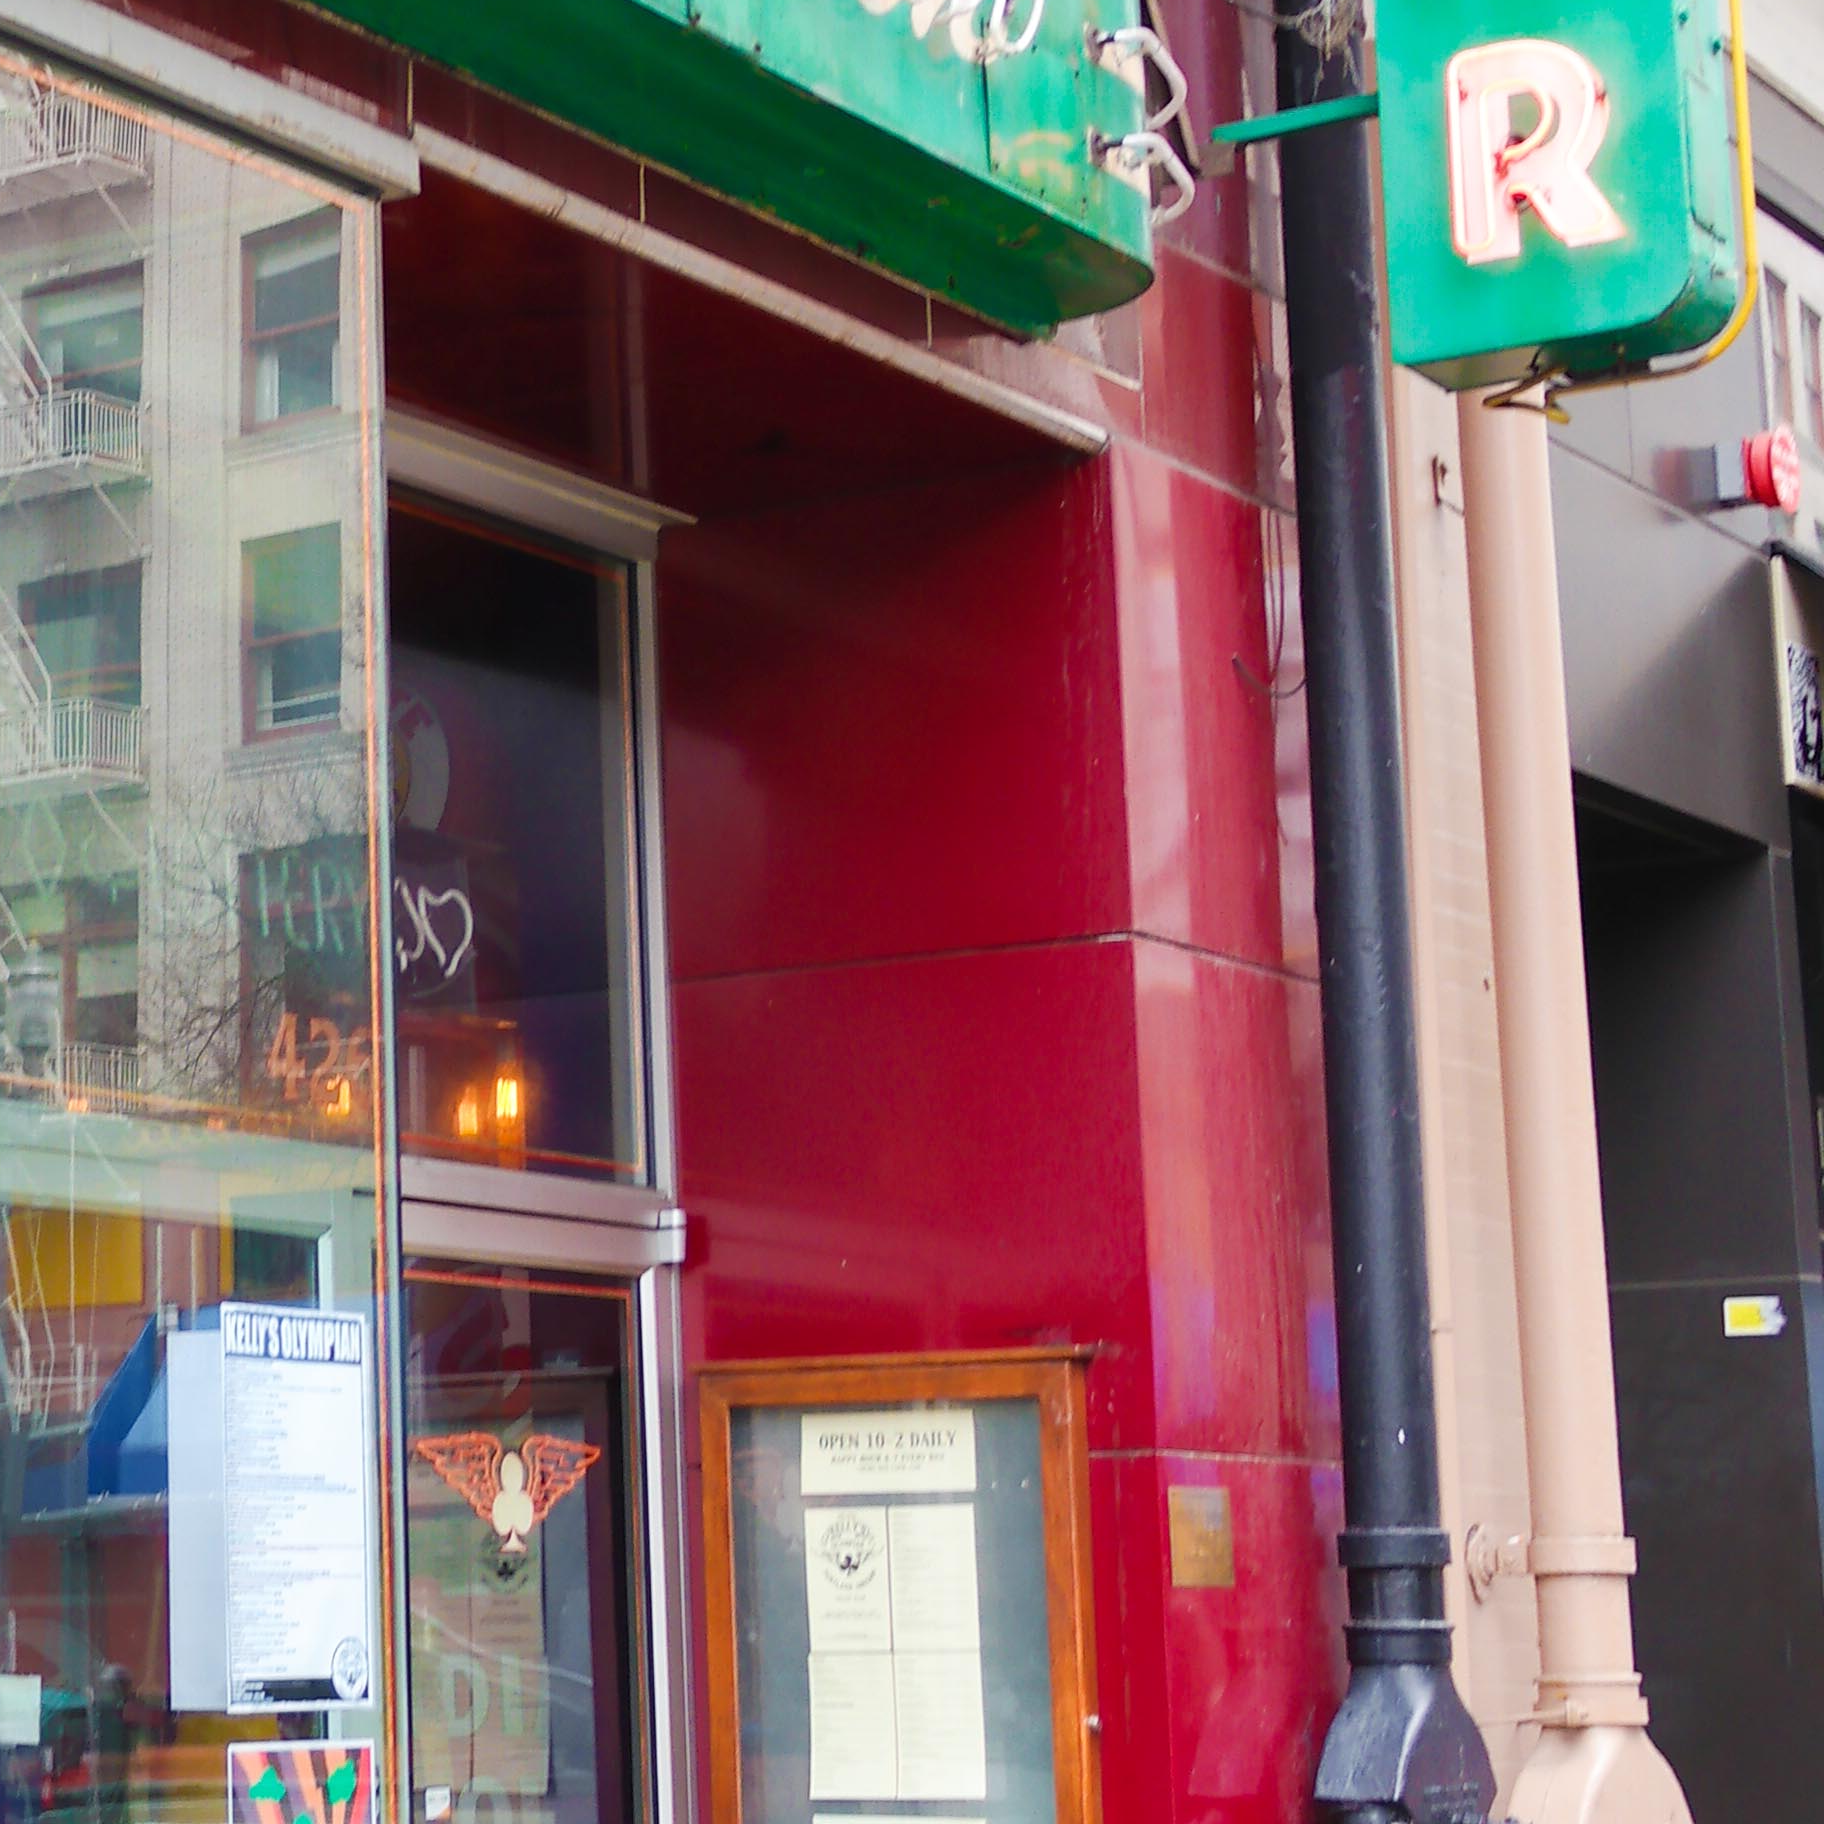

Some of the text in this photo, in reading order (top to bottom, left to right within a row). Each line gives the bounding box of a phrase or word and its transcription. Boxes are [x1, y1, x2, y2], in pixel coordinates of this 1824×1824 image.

[226, 1312, 362, 1363] KELLY'S OLYMPIAN
[819, 1433, 860, 1451] OPEN
[910, 1429, 957, 1449] DAILY
